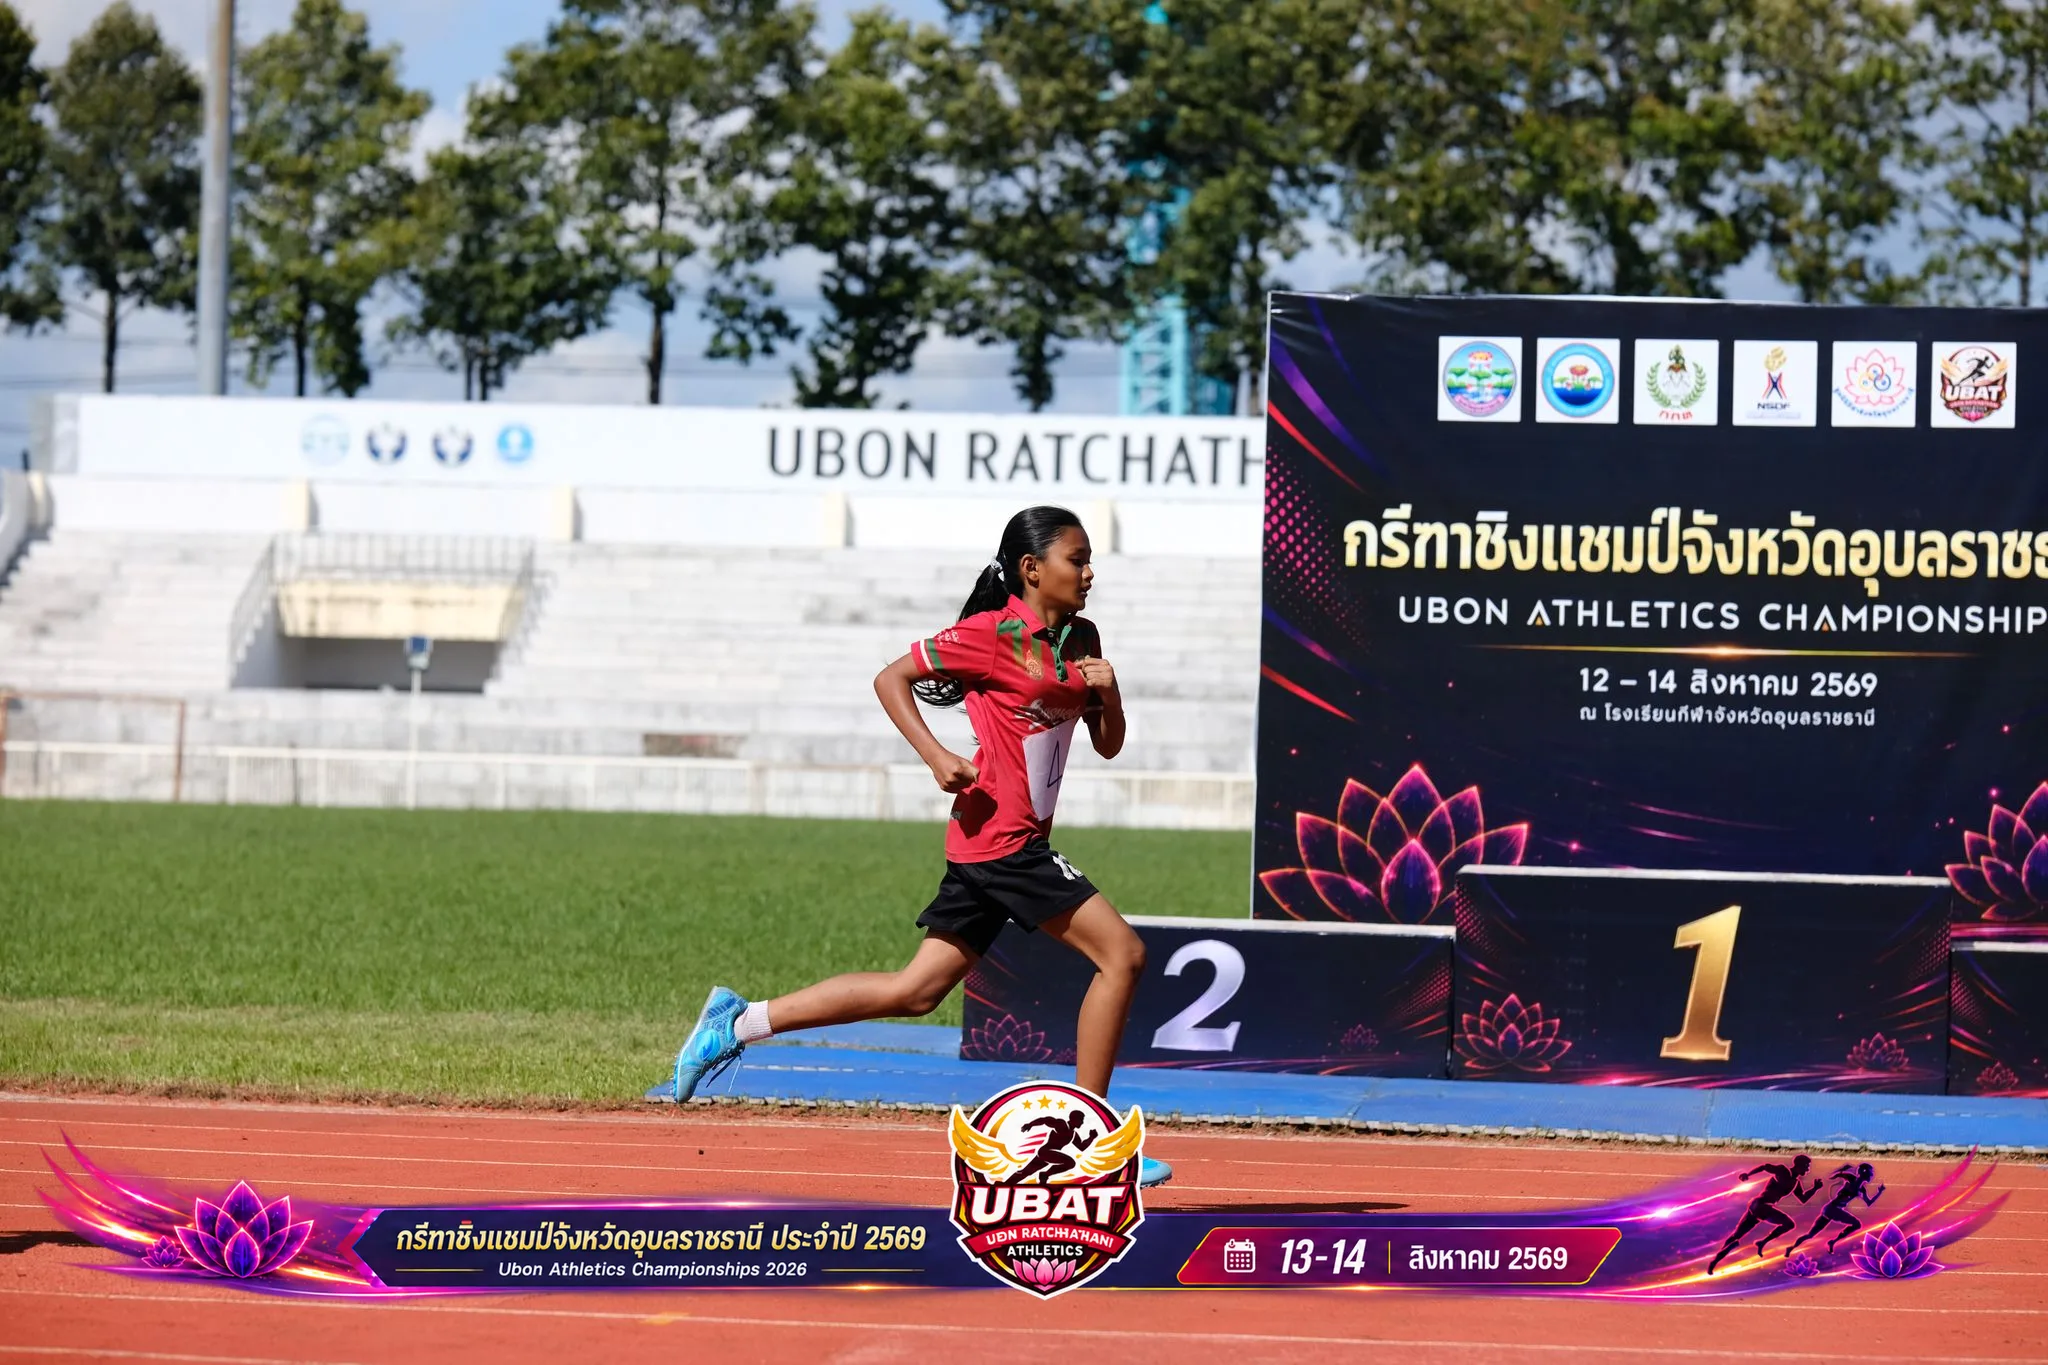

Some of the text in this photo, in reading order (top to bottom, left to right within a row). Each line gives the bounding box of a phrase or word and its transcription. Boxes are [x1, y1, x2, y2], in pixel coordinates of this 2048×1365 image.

[1944, 385, 2003, 402] UBAT
[769, 427, 936, 479] UBON
[1399, 596, 1508, 626] UBON
[1526, 599, 1740, 630] ATHLETICS
[1580, 668, 1609, 693] 12
[1648, 669, 1678, 694] 14
[1690, 668, 1799, 696] สิงหาคม
[1810, 672, 1878, 698] 2569
[1579, 707, 1597, 721] ณ
[1151, 938, 1246, 1053] 2
[1659, 904, 1742, 1062] 1
